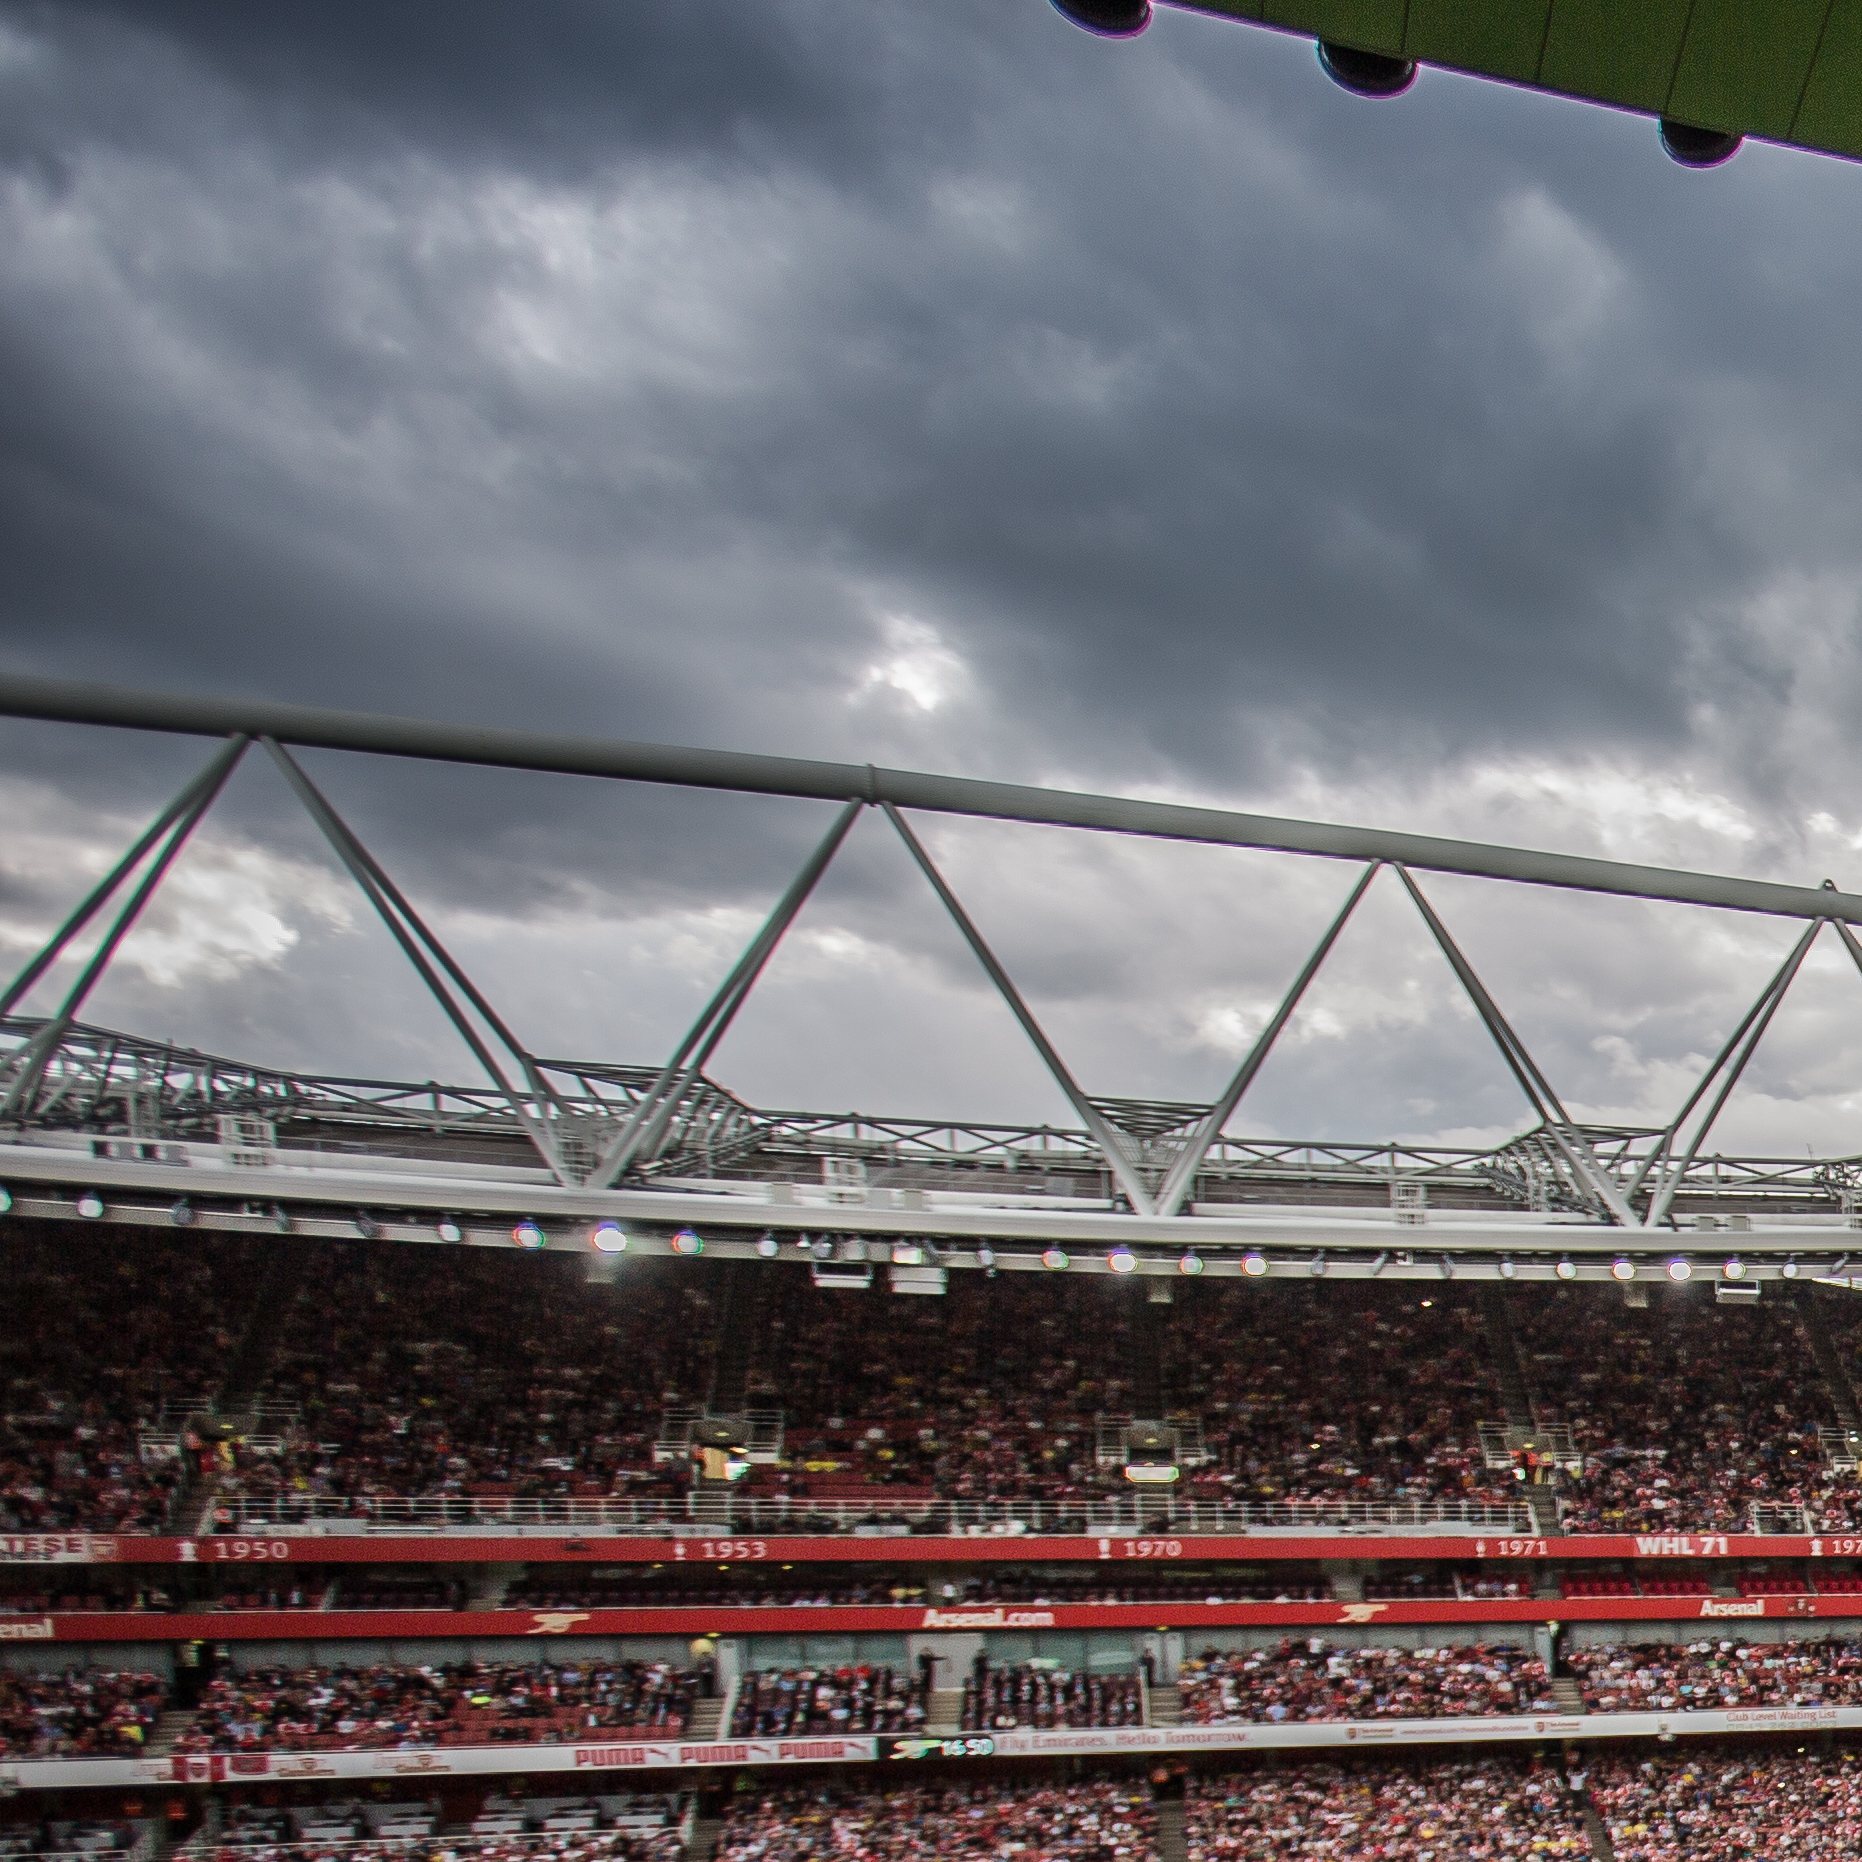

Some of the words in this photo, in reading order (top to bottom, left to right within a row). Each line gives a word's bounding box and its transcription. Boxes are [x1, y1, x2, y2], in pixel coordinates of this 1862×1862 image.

[215, 1541, 289, 1558] 1950
[703, 1541, 767, 1559] 1953
[1125, 1540, 1182, 1558] 1970
[1498, 1539, 1548, 1556] 1971
[1636, 1537, 1695, 1555] WHL
[1701, 1537, 1729, 1555] 71
[1700, 1599, 1766, 1617] Arsenal
[923, 1609, 1054, 1629] Arsenal.com
[1778, 1710, 1817, 1722] Waiting
[1819, 1710, 1837, 1719] List
[576, 1748, 646, 1768] PUMA
[680, 1745, 749, 1764] PUMA
[778, 1741, 846, 1760] PUMA
